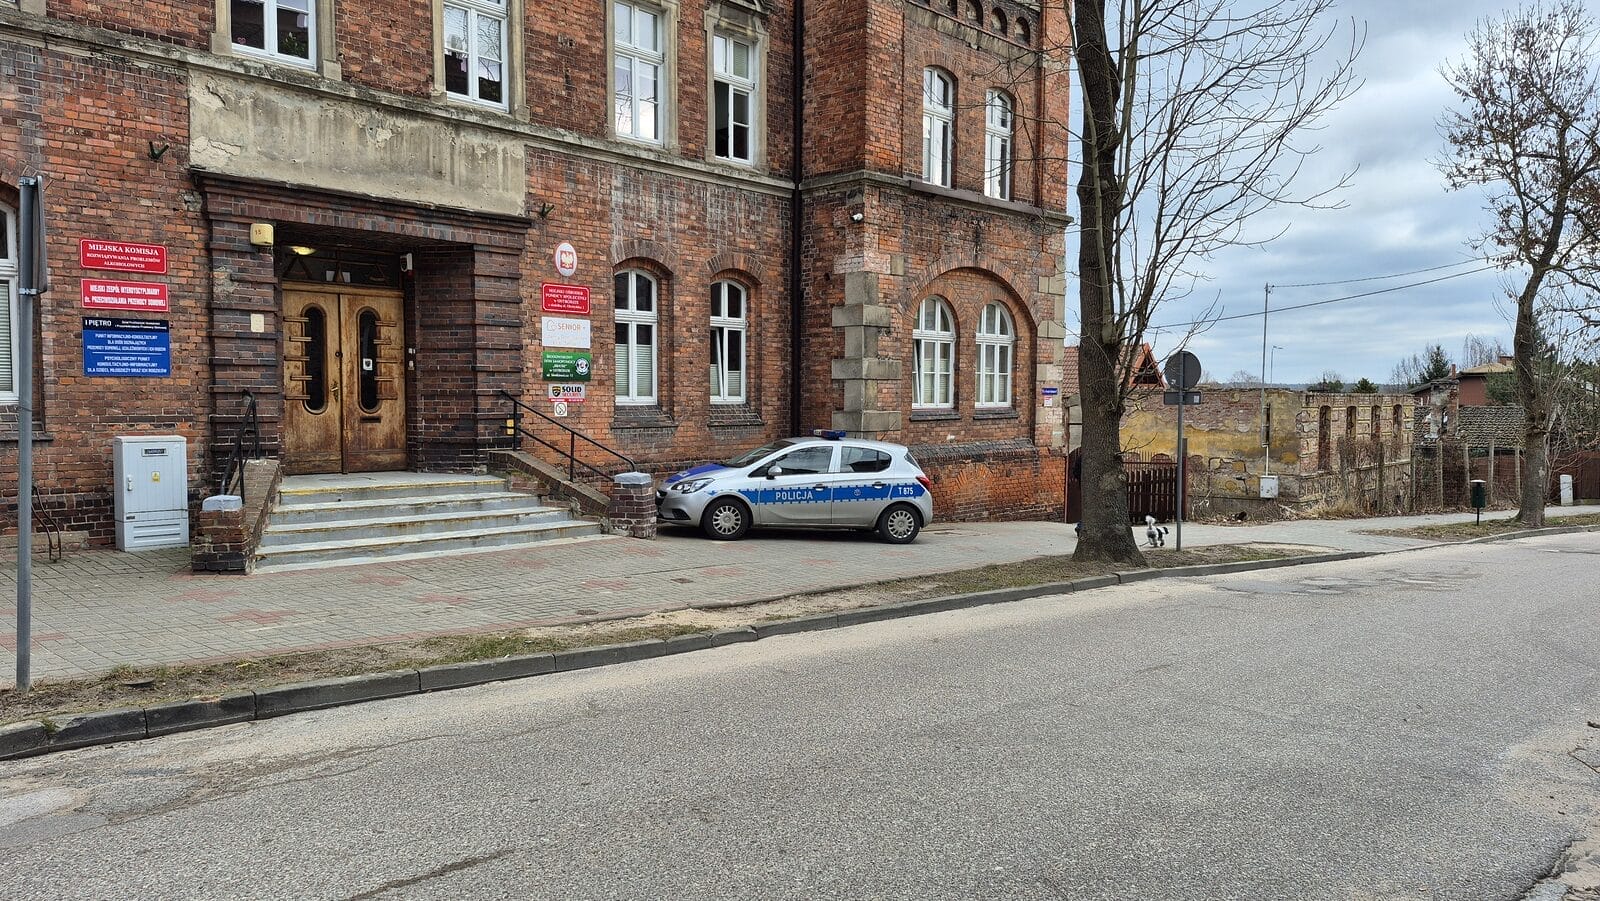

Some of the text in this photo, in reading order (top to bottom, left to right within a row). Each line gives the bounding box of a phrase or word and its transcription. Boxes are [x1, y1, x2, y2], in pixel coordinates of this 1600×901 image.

[88, 244, 159, 255] MIEJSKA KOMISJA
[775, 491, 813, 500] POLICJA
